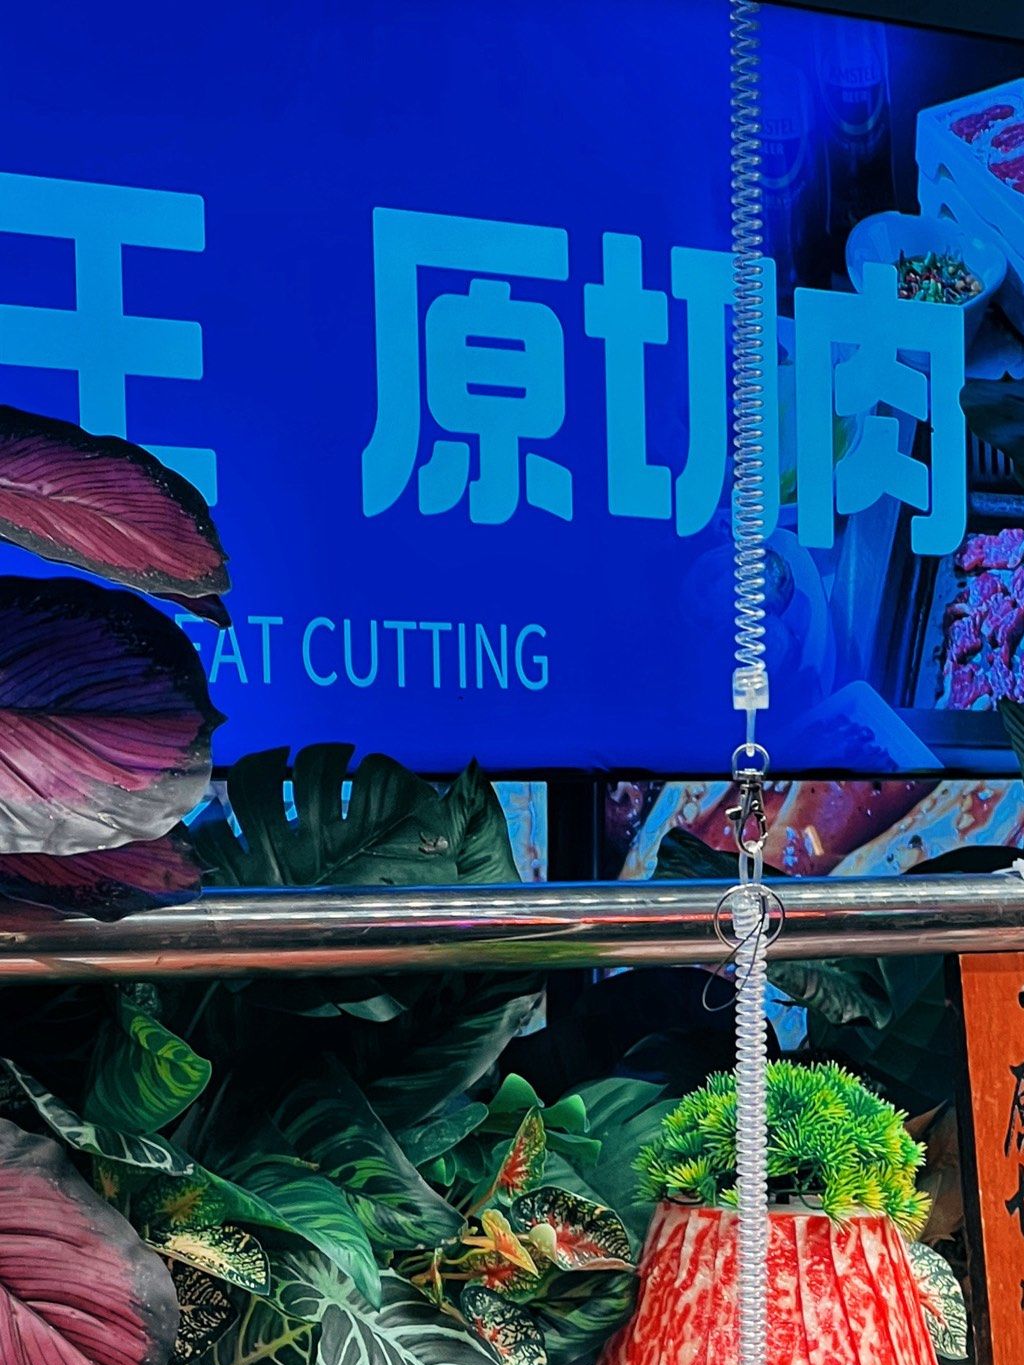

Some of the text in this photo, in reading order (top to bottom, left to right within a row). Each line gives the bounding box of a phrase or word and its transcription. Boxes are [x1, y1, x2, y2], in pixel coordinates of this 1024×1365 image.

[362, 206, 968, 555] 原切肉
[301, 618, 550, 692] CUTTING
